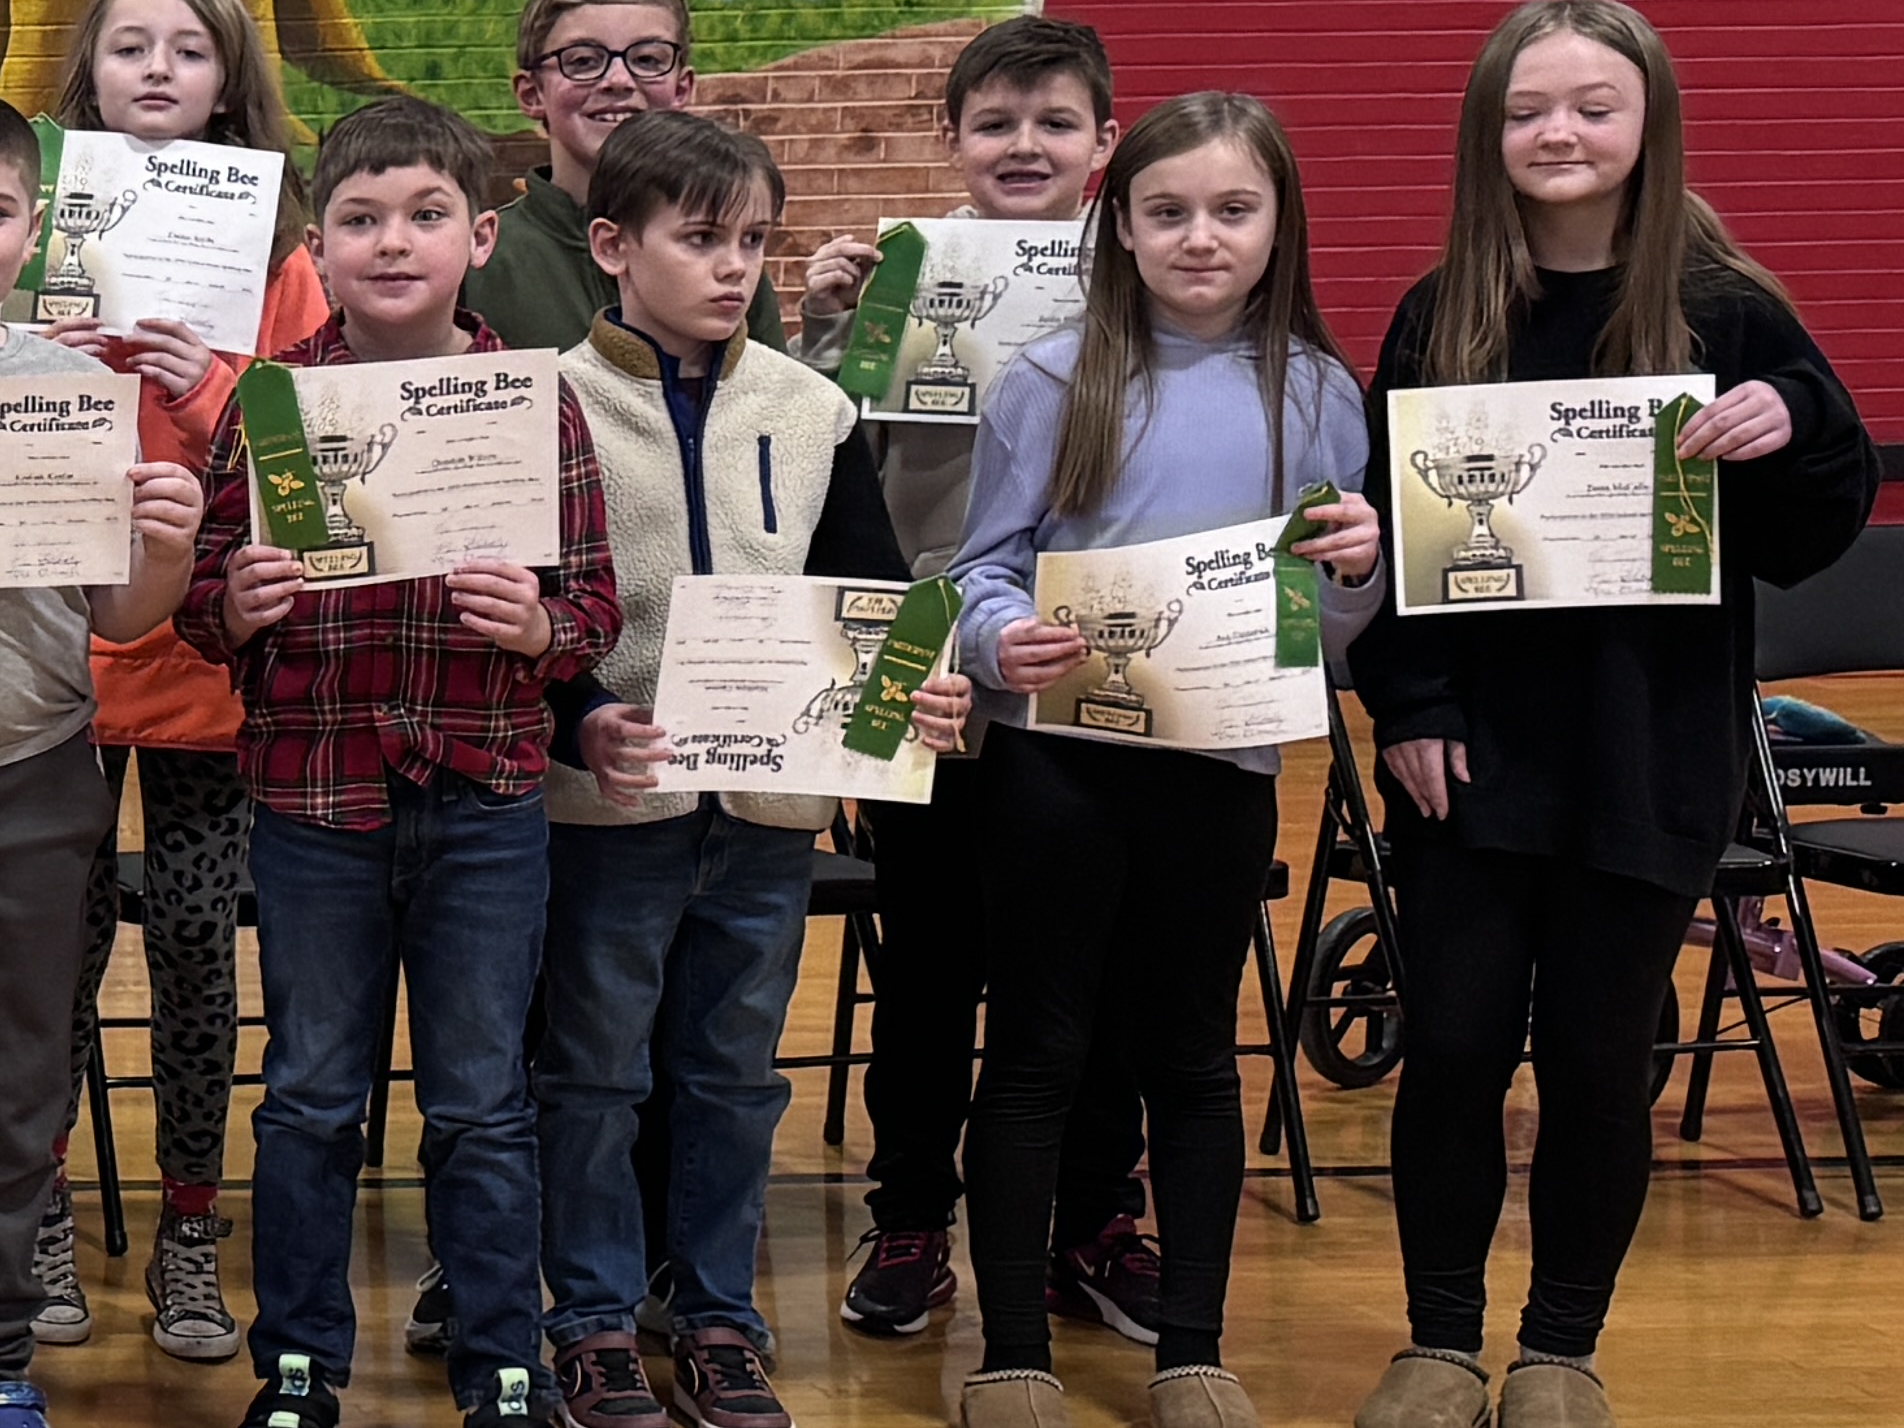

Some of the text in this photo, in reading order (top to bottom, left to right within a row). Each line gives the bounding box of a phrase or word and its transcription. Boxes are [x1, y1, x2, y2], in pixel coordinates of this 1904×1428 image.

[145, 155, 259, 187] Spelling Bee
[164, 181, 235, 201] Certificate
[400, 373, 533, 402] Spelling Bee
[76, 394, 114, 412] Bee
[425, 398, 508, 417] Certificate
[1549, 399, 1641, 425] Spelling
[9, 417, 90, 434] Certificate
[1185, 549, 1254, 579] Spelling
[668, 749, 784, 773] Spelling Bee
